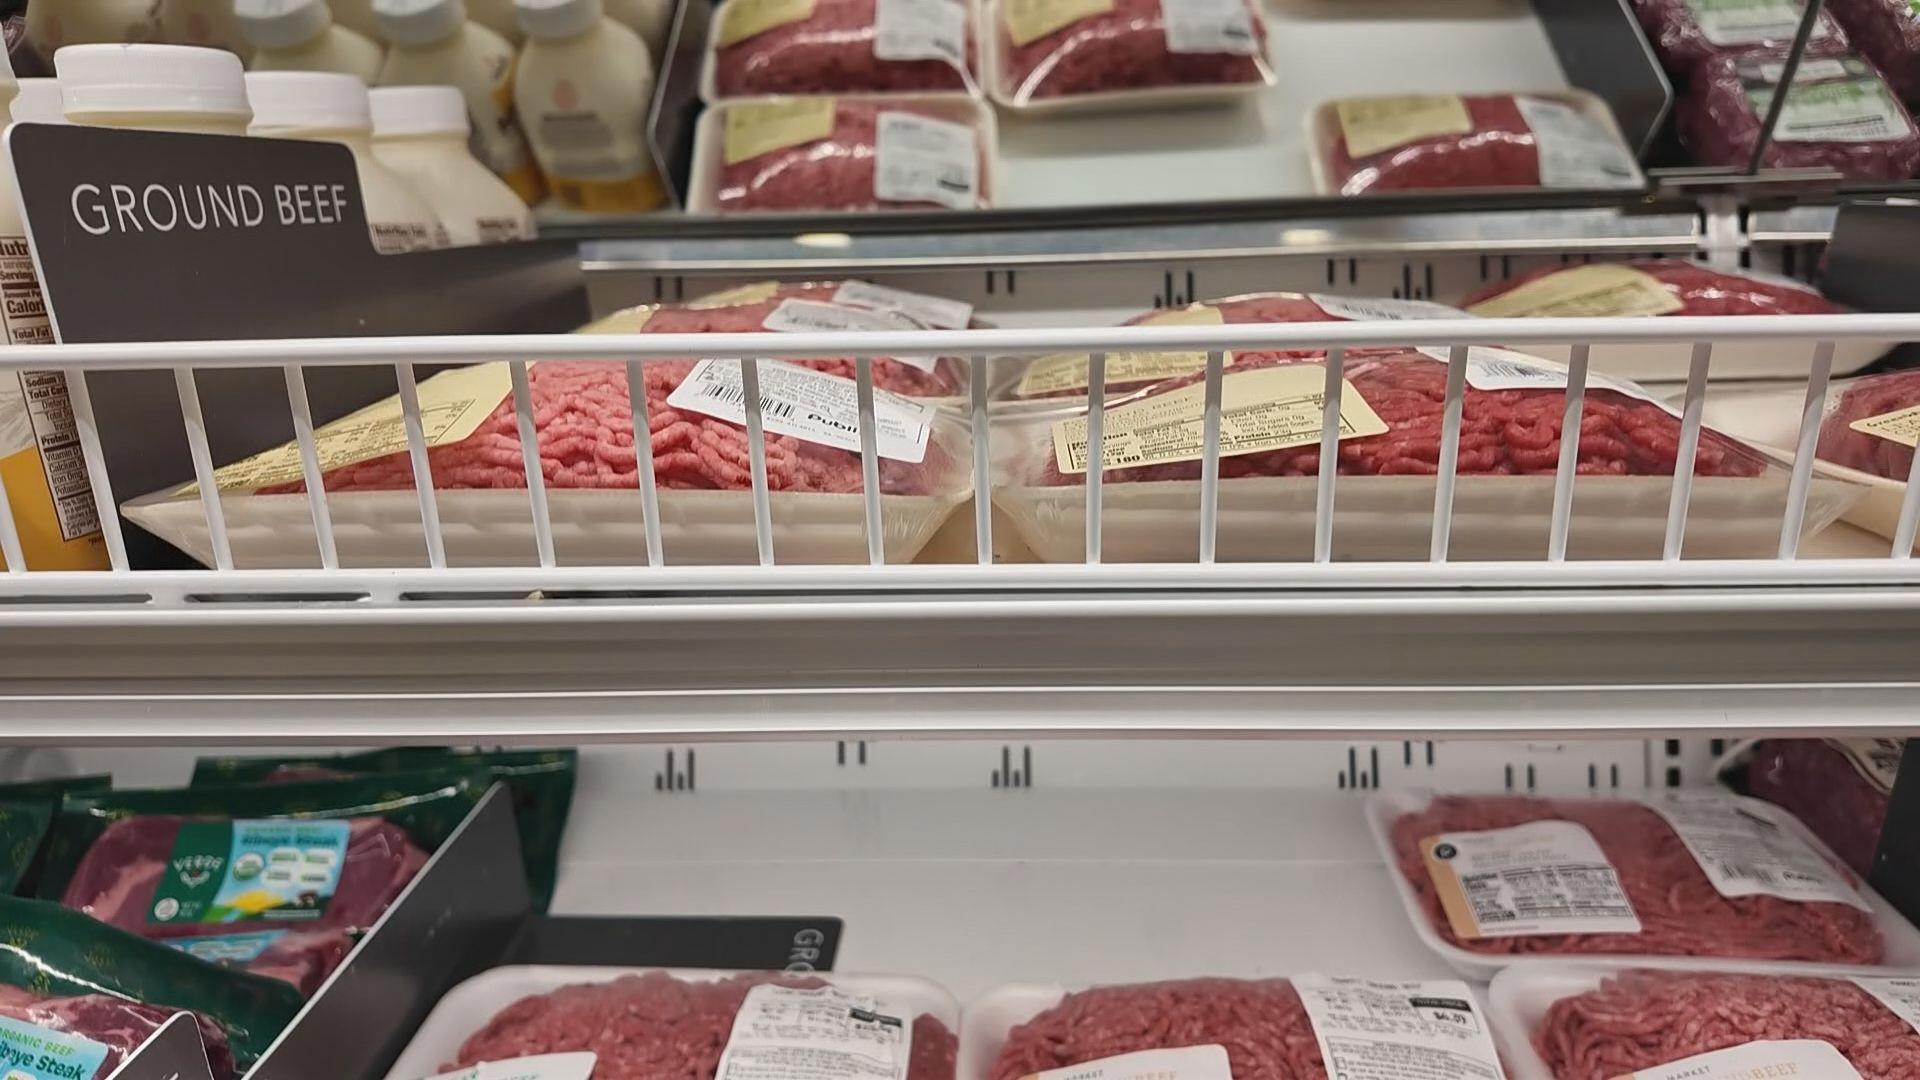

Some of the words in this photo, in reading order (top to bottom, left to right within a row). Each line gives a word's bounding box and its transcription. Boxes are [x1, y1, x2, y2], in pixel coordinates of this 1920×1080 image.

[71, 184, 264, 234] GROUND
[274, 185, 347, 225] BEEF
[13, 328, 35, 340] Total
[26, 376, 56, 388] Sodium
[29, 390, 50, 399] Total
[807, 413, 859, 434] Publi
[41, 434, 69, 446] Protein
[1234, 431, 1271, 441] Protein
[45, 450, 73, 461] Vitamin
[49, 461, 78, 473] Calcium
[52, 475, 66, 484] Iron
[44, 1042, 74, 1057] BEEF
[36, 1055, 86, 1080] Steak
[1666, 1065, 1712, 1080] MARKET
